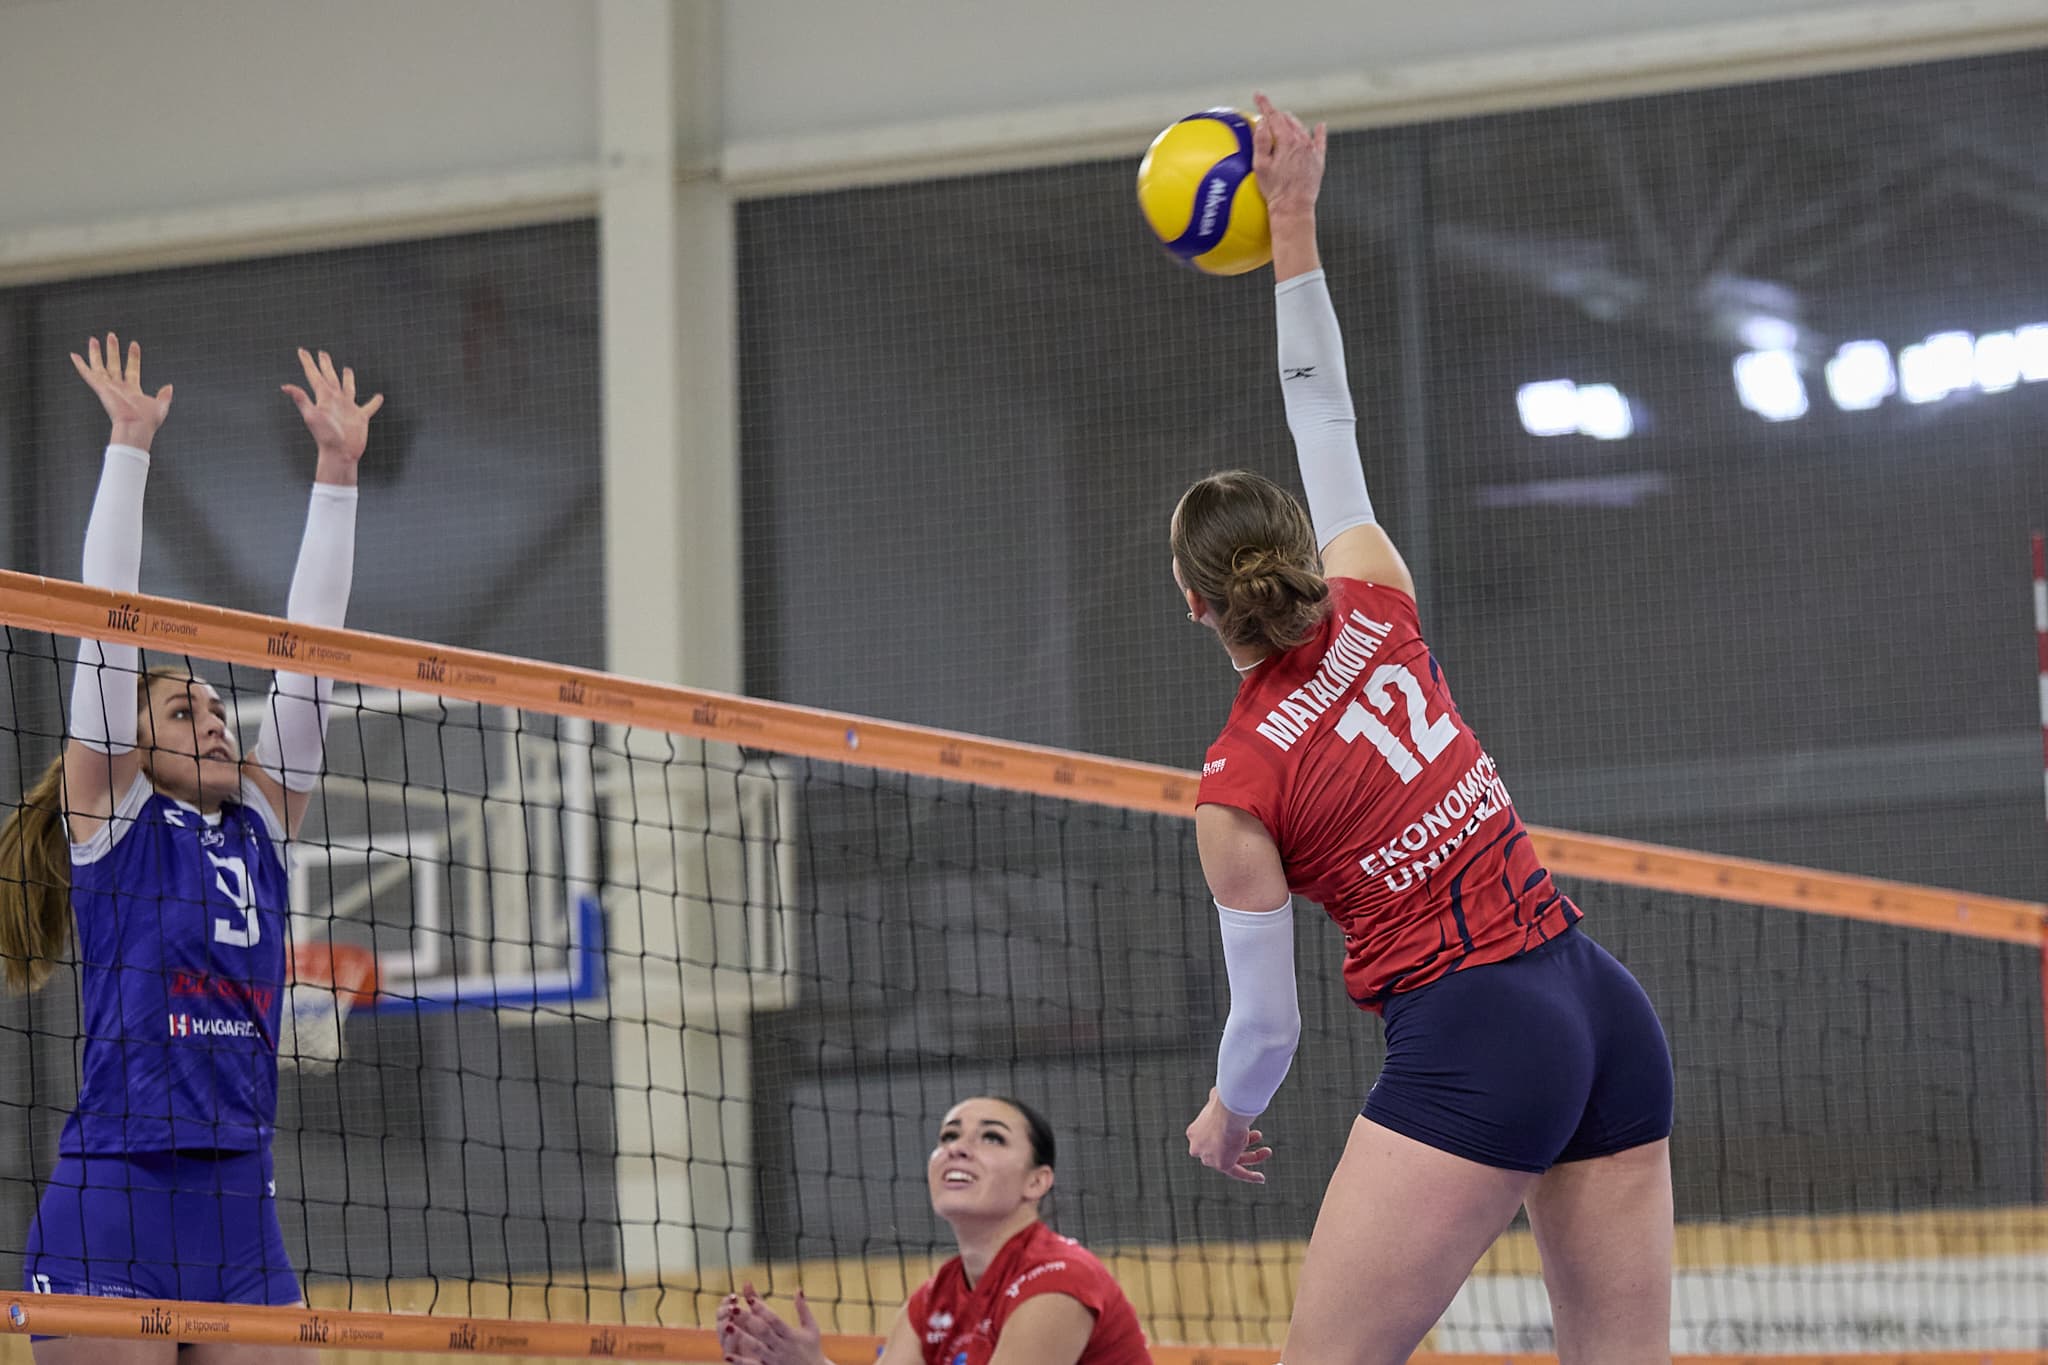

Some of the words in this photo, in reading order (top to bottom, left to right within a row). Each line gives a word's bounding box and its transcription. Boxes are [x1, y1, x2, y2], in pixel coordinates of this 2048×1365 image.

[1334, 663, 1460, 785] 12
[207, 850, 261, 948] 9
[141, 1307, 172, 1335] niké
